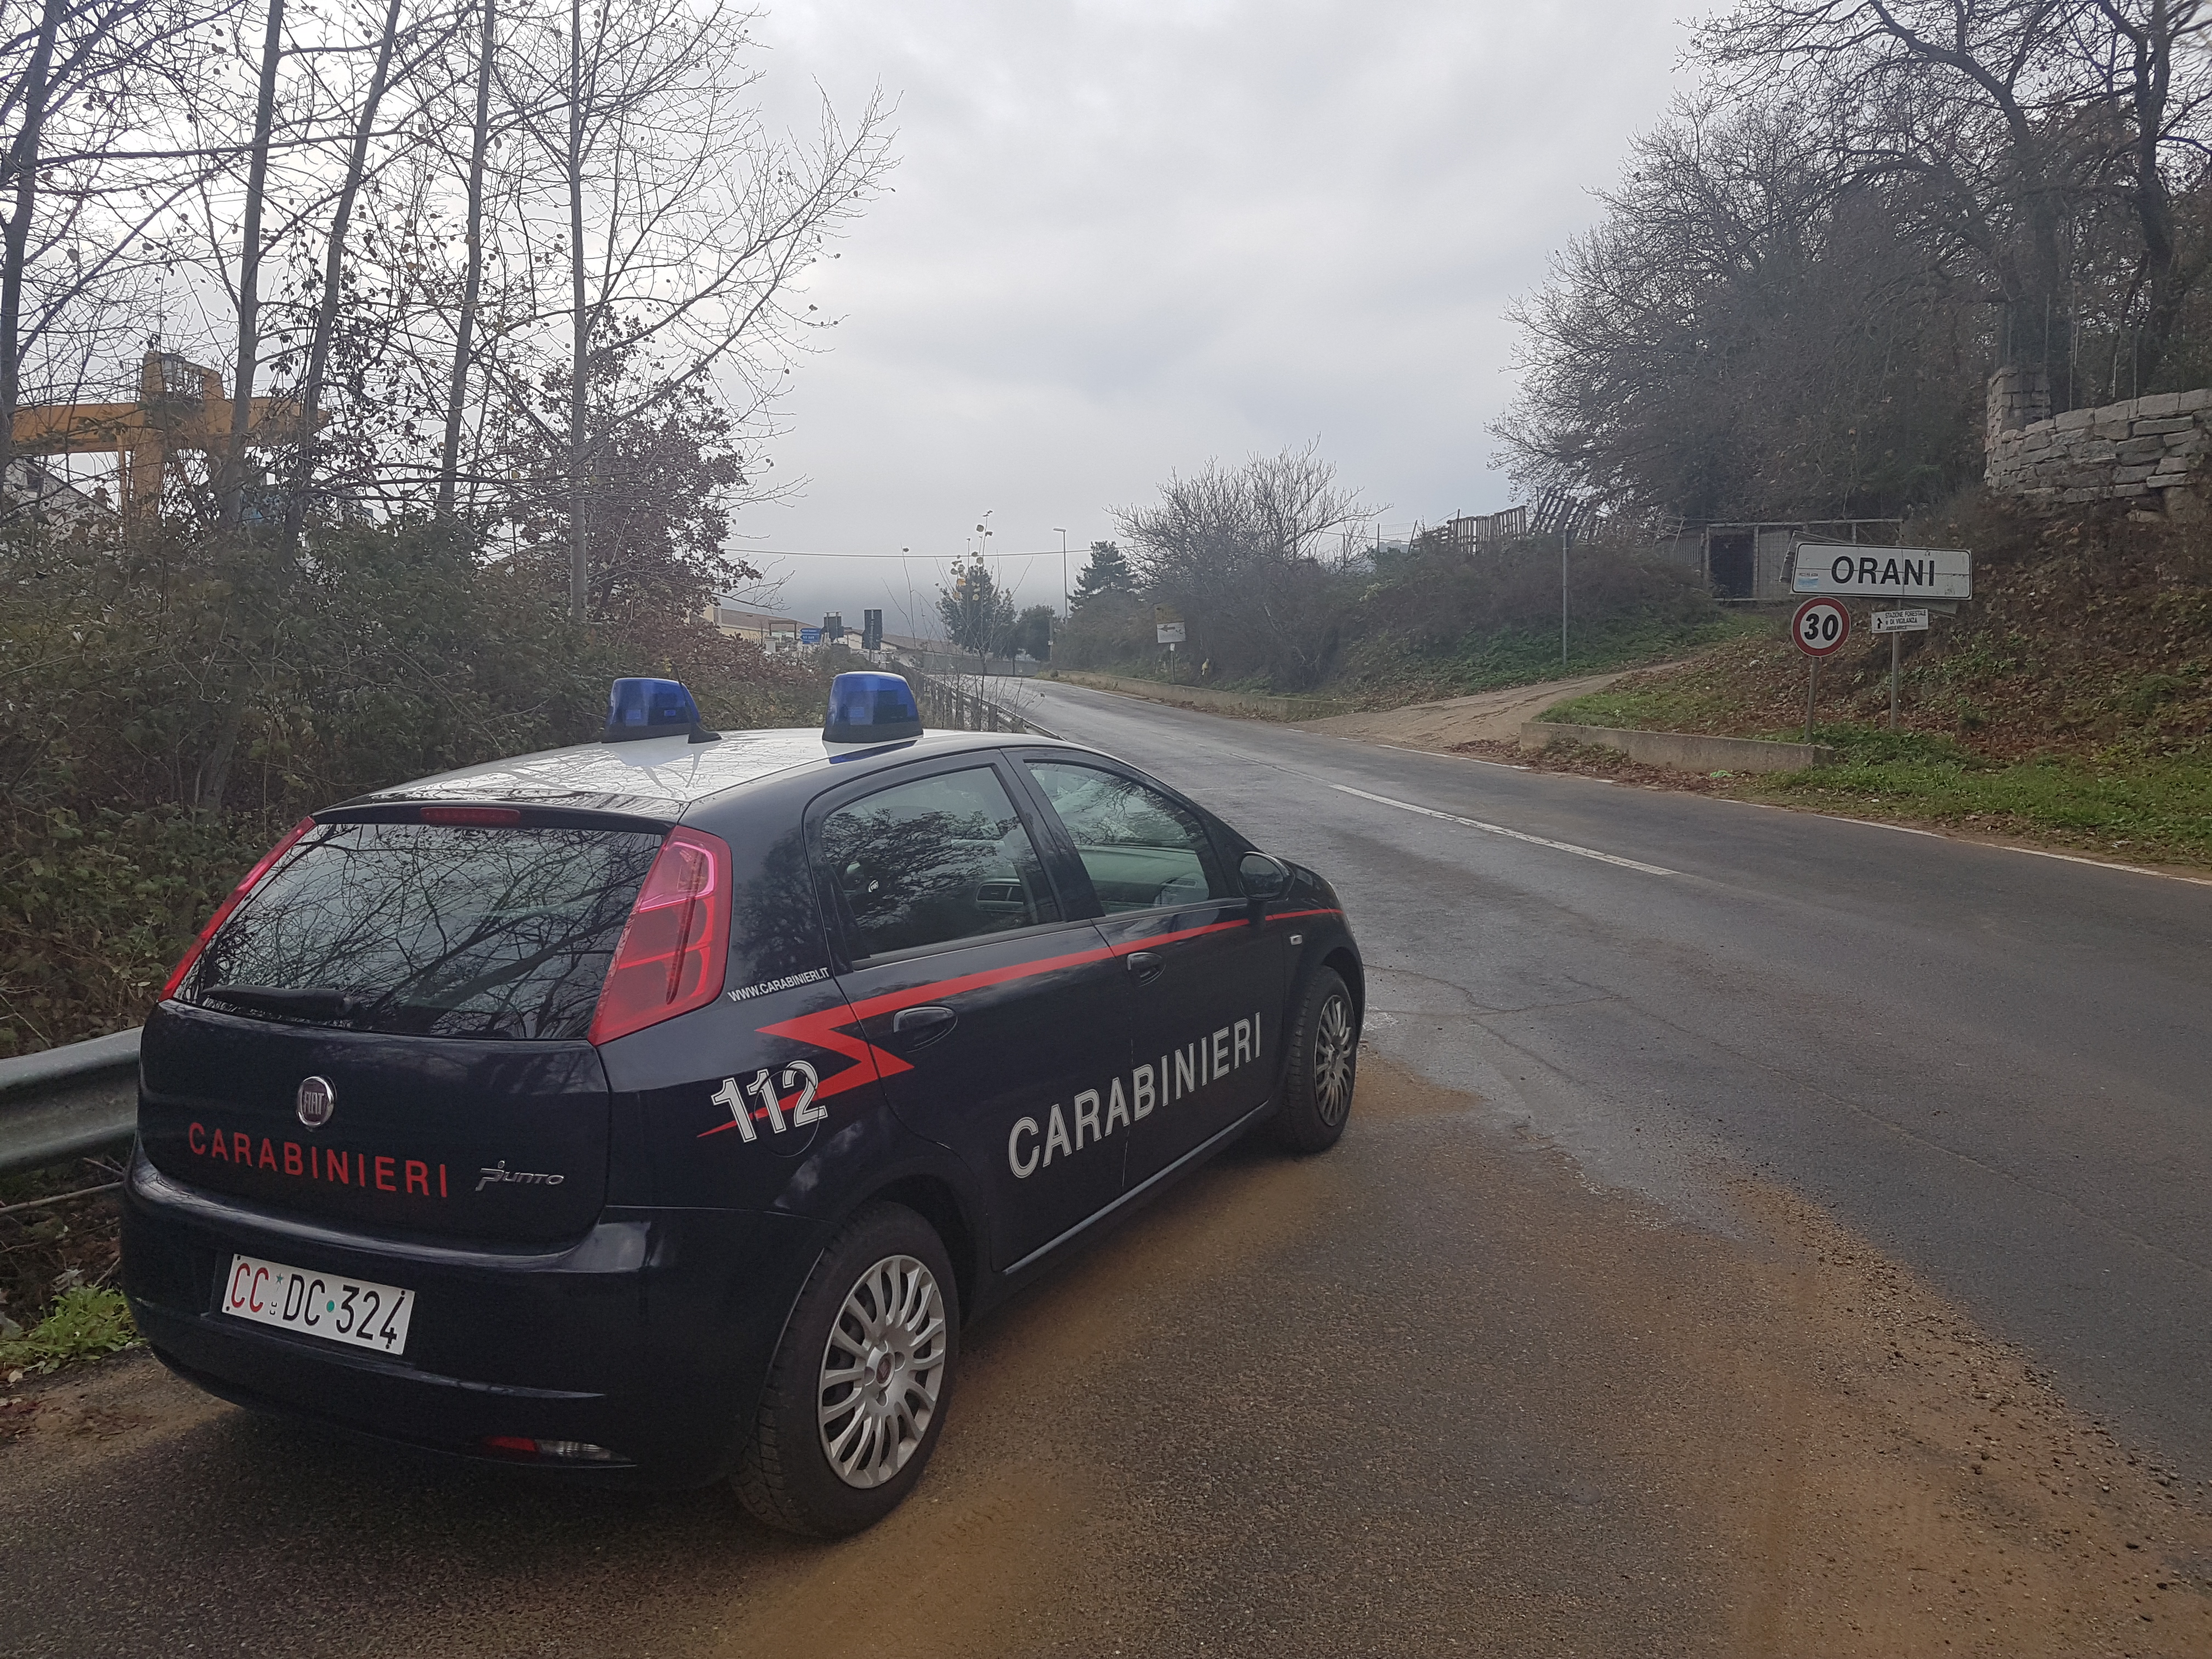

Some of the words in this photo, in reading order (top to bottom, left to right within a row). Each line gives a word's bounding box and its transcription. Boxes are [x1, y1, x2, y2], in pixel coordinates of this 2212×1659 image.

[1831, 556, 1934, 586] ORANI
[1804, 613, 1839, 641] 30
[727, 967, 830, 1002] WWW.CARABINIERI.IT
[303, 1091, 325, 1115] FIAT
[710, 1060, 828, 1143] 112
[1008, 1012, 1261, 1179] CARABINIERI
[189, 1122, 447, 1198] CARABINIERI
[231, 1263, 269, 1313] CC
[282, 1273, 326, 1327] DC
[336, 1284, 405, 1345] 324
